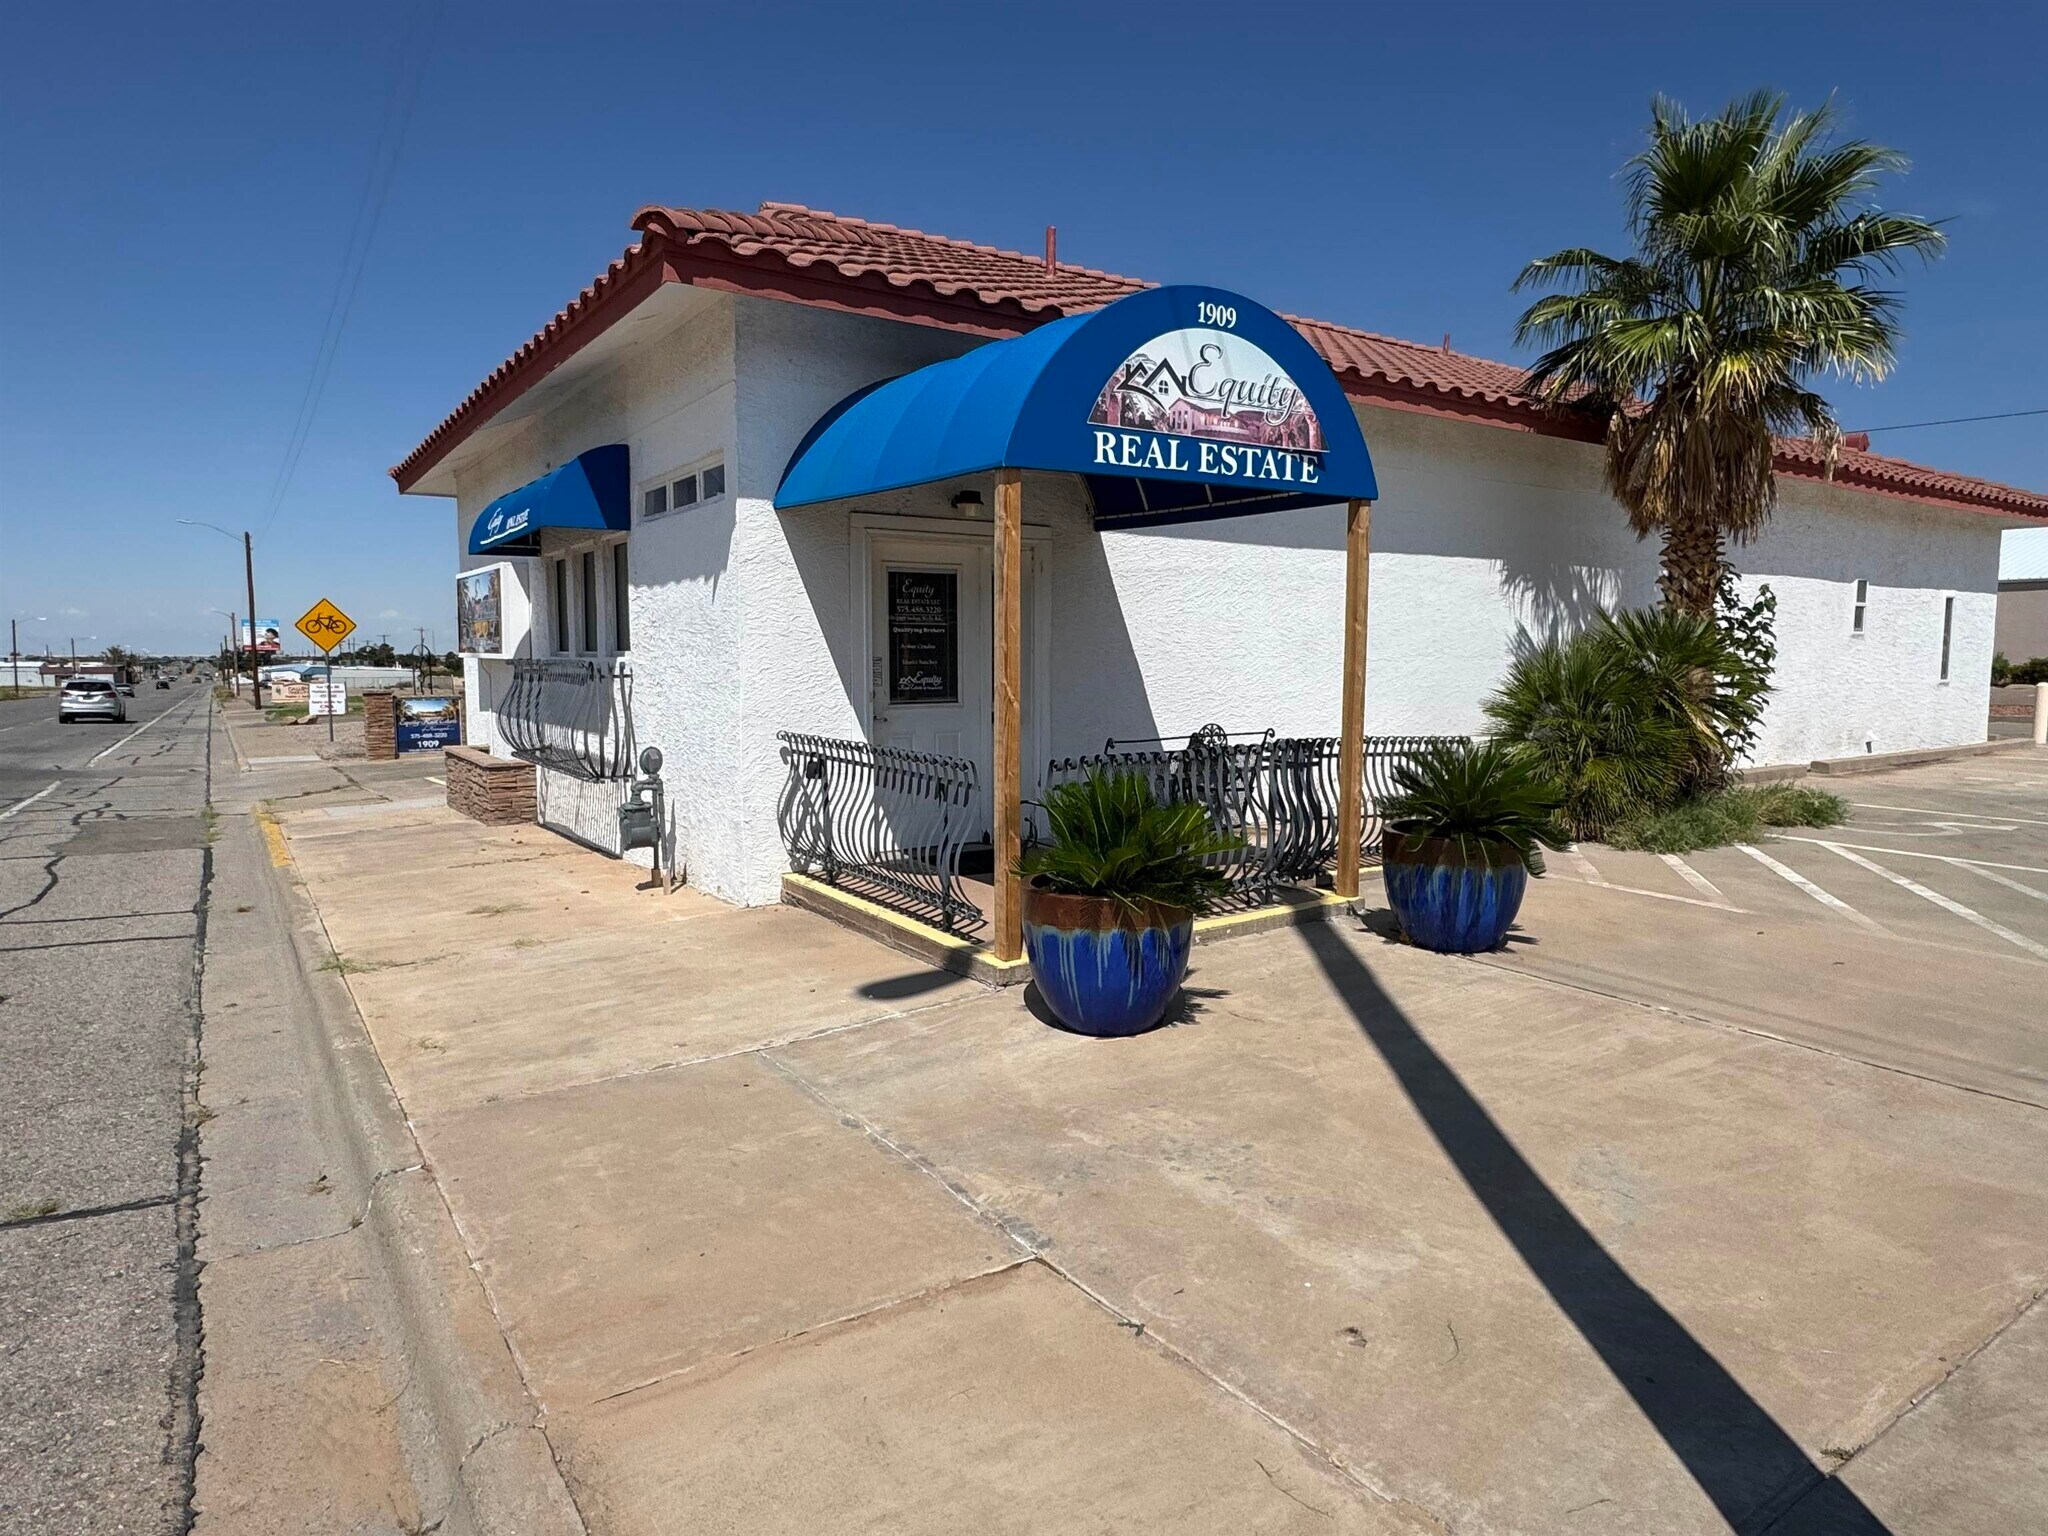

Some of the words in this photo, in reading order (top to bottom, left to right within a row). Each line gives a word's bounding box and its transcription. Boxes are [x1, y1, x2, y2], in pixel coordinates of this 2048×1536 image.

[1198, 301, 1237, 329] 1909
[1188, 343, 1299, 426] Equity
[1093, 431, 1189, 472] REAL
[1198, 442, 1319, 484] ESTATE
[902, 579, 935, 599] Equity
[892, 626, 923, 634] Qualifying
[417, 740, 440, 748] 1909
